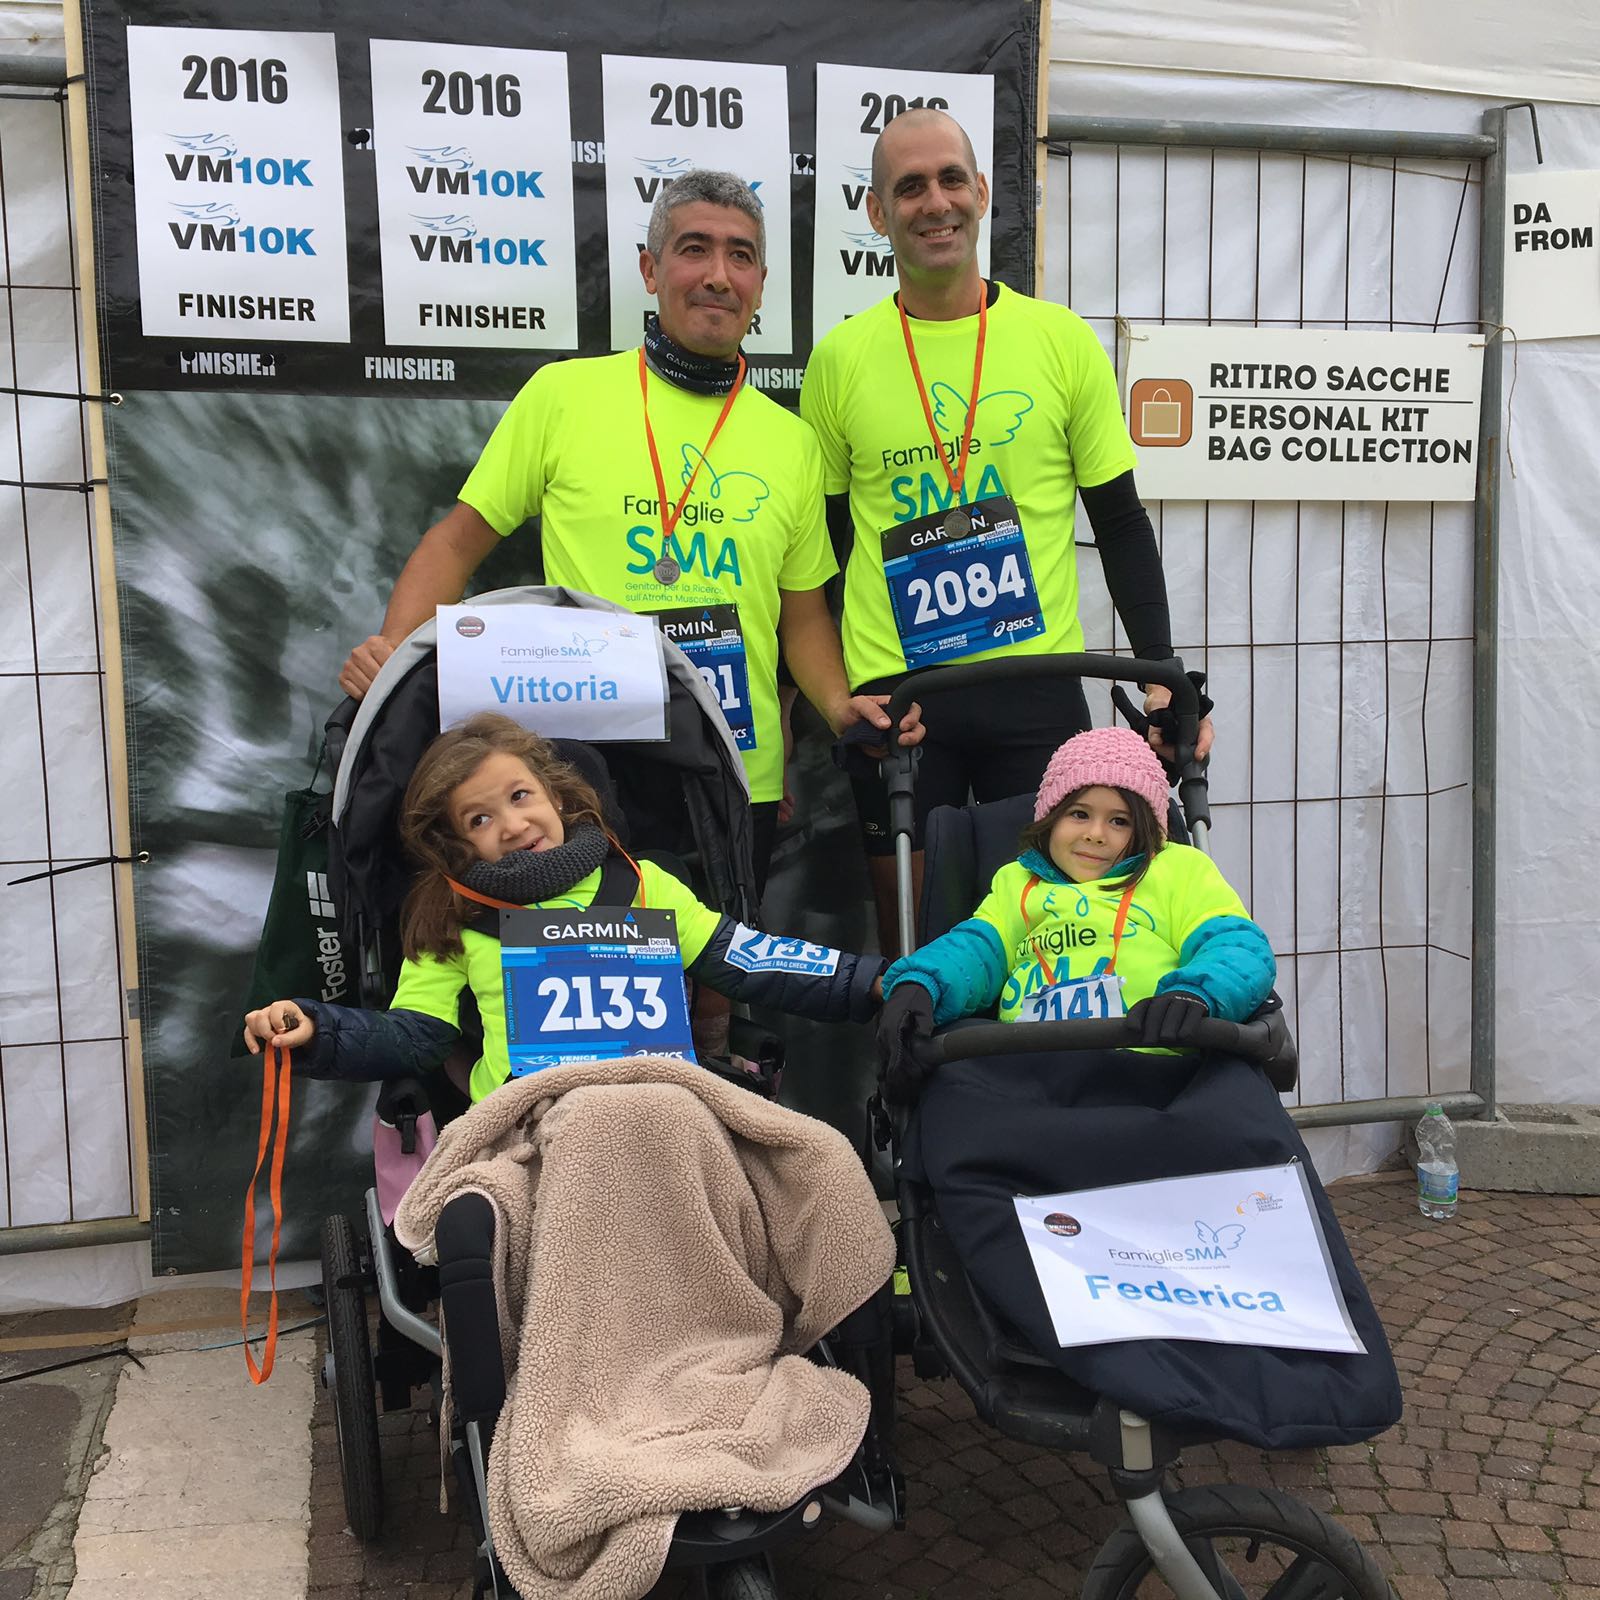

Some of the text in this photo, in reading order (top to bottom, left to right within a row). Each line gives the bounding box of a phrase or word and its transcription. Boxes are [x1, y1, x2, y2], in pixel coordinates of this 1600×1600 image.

[181, 55, 289, 104] 2016
[421, 69, 522, 118] 2016
[649, 82, 744, 130] 2016
[165, 151, 314, 187] VM10K
[405, 165, 546, 199] VM10K
[1513, 202, 1552, 225] DA
[168, 221, 317, 257] VM10K
[409, 234, 549, 267] VM10K
[1515, 227, 1593, 252] FROM
[178, 292, 316, 322] FINISHER
[418, 303, 547, 330] FINISHER
[364, 356, 456, 381] FINISHER
[1210, 363, 1450, 393] RITIRO SACCHE
[1209, 404, 1430, 432] PERSONAL KIT
[1208, 436, 1472, 464] BAG COLLECTION
[890, 463, 1008, 523] SMA
[911, 515, 985, 546] GARN
[626, 525, 742, 587] SMA
[907, 554, 1027, 625] 2084
[664, 620, 714, 637] RMIN
[938, 633, 967, 645] VENICE
[490, 674, 619, 703] Vittoria
[316, 927, 348, 1003] Foster
[537, 976, 667, 1032] 2133
[1033, 981, 1109, 1022] 2141
[1085, 1275, 1287, 1313] Federica
